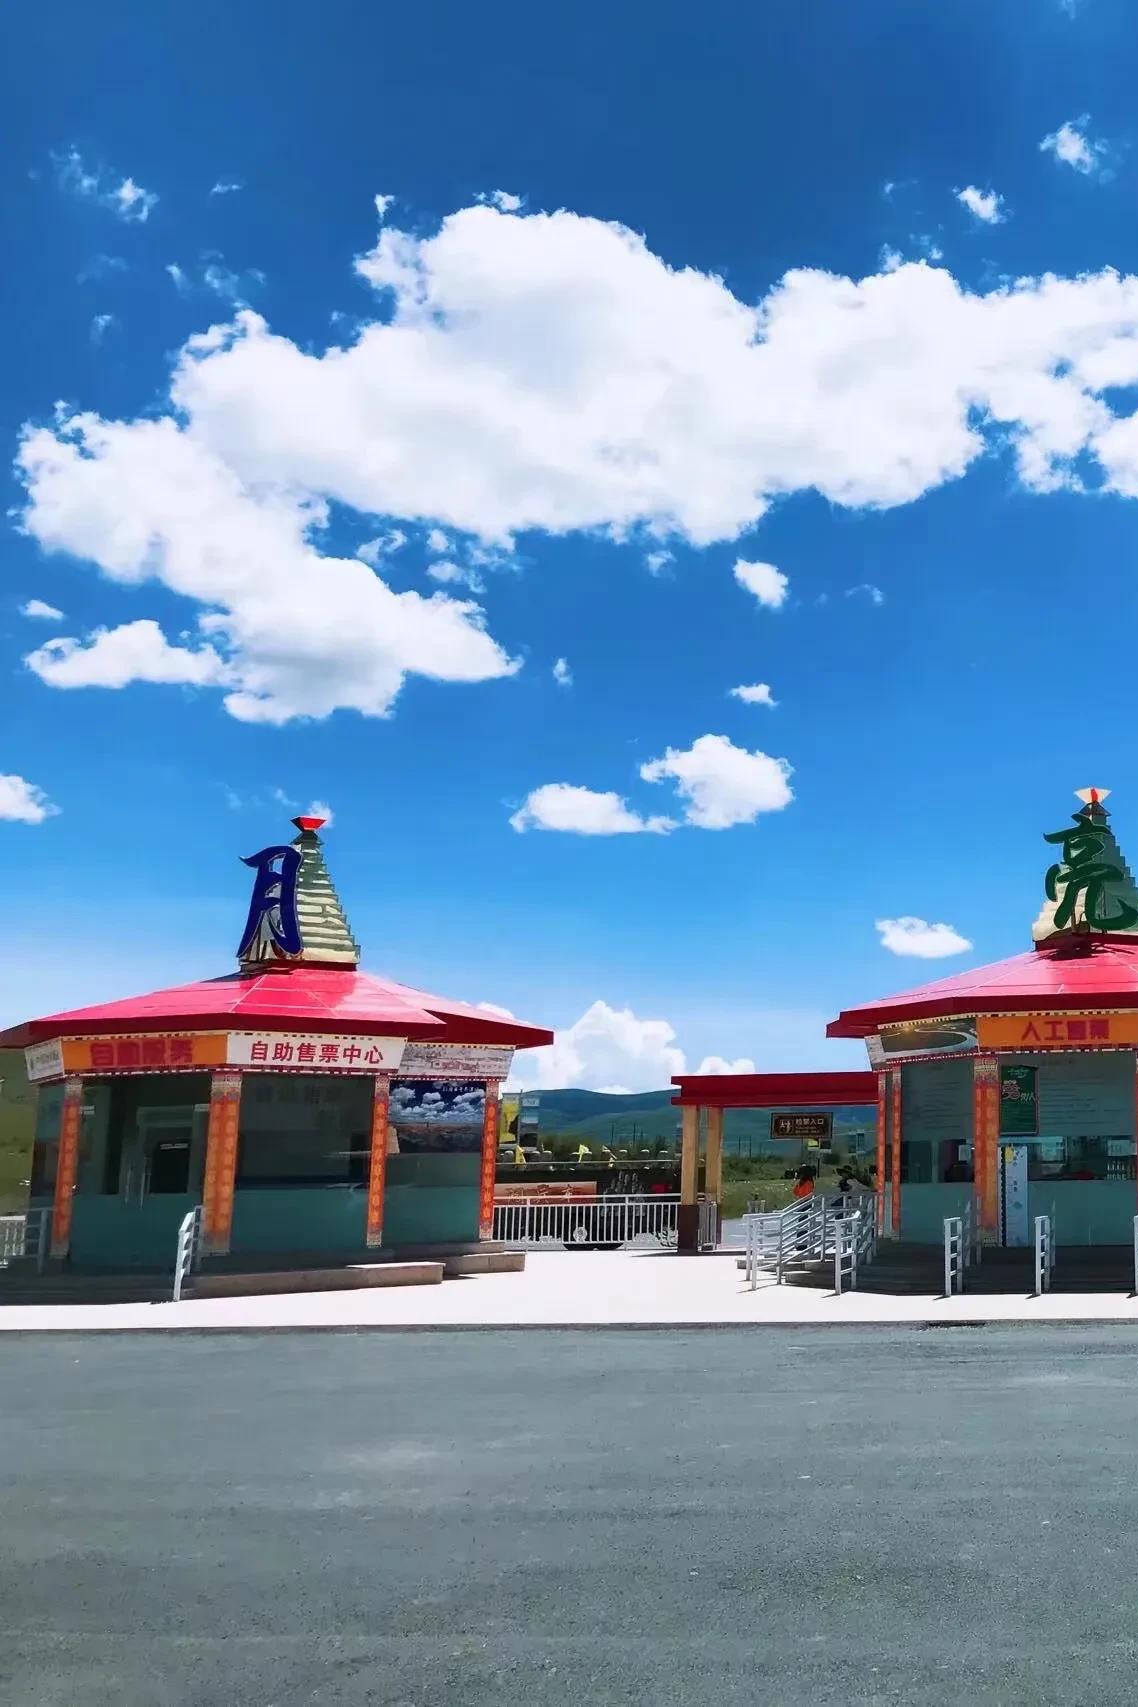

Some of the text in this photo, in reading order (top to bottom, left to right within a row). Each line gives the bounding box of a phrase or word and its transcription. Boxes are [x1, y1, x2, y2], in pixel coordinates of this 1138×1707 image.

[236, 845, 304, 958] 月
[1043, 812, 1138, 931] 亮
[250, 1040, 384, 1065] 自助售票中心
